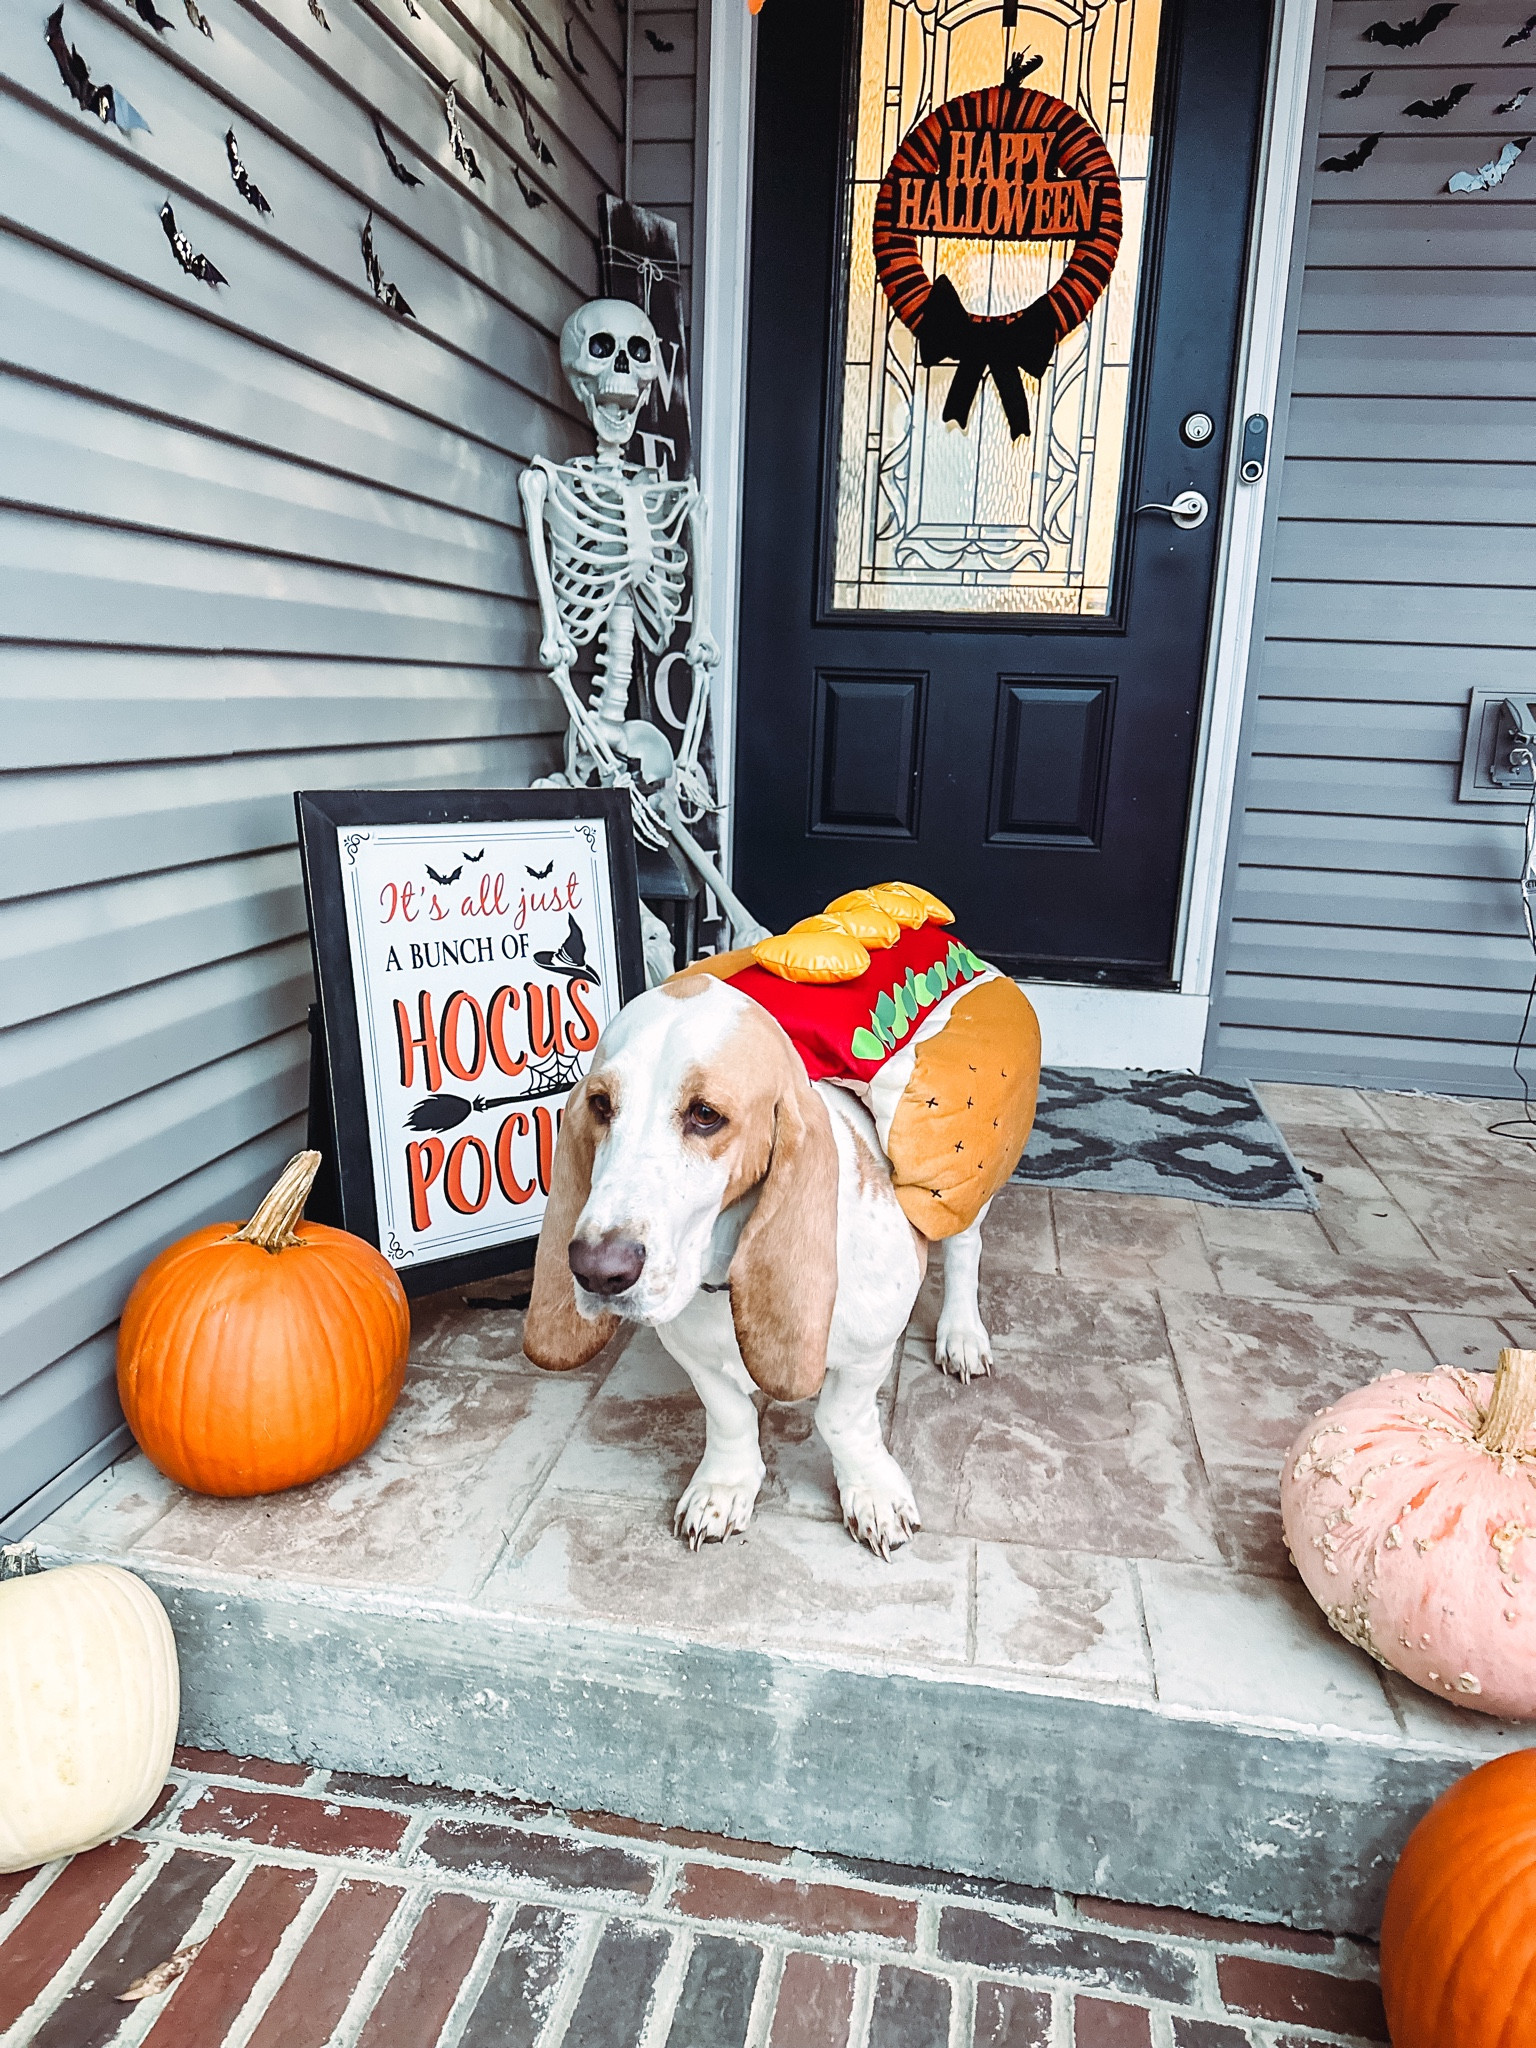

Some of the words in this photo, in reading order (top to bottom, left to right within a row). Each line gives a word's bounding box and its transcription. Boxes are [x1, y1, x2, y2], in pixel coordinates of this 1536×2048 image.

[950, 131, 1056, 187] HAPPY
[897, 177, 1099, 235] HALLOWEEN
[379, 881, 450, 924] It's
[461, 872, 510, 917] all
[513, 871, 583, 931] just
[385, 945, 403, 972] A
[409, 936, 495, 970] BUNCH
[501, 932, 529, 960] OF
[393, 978, 600, 1093] HOCUS
[405, 1106, 565, 1233] POCU
